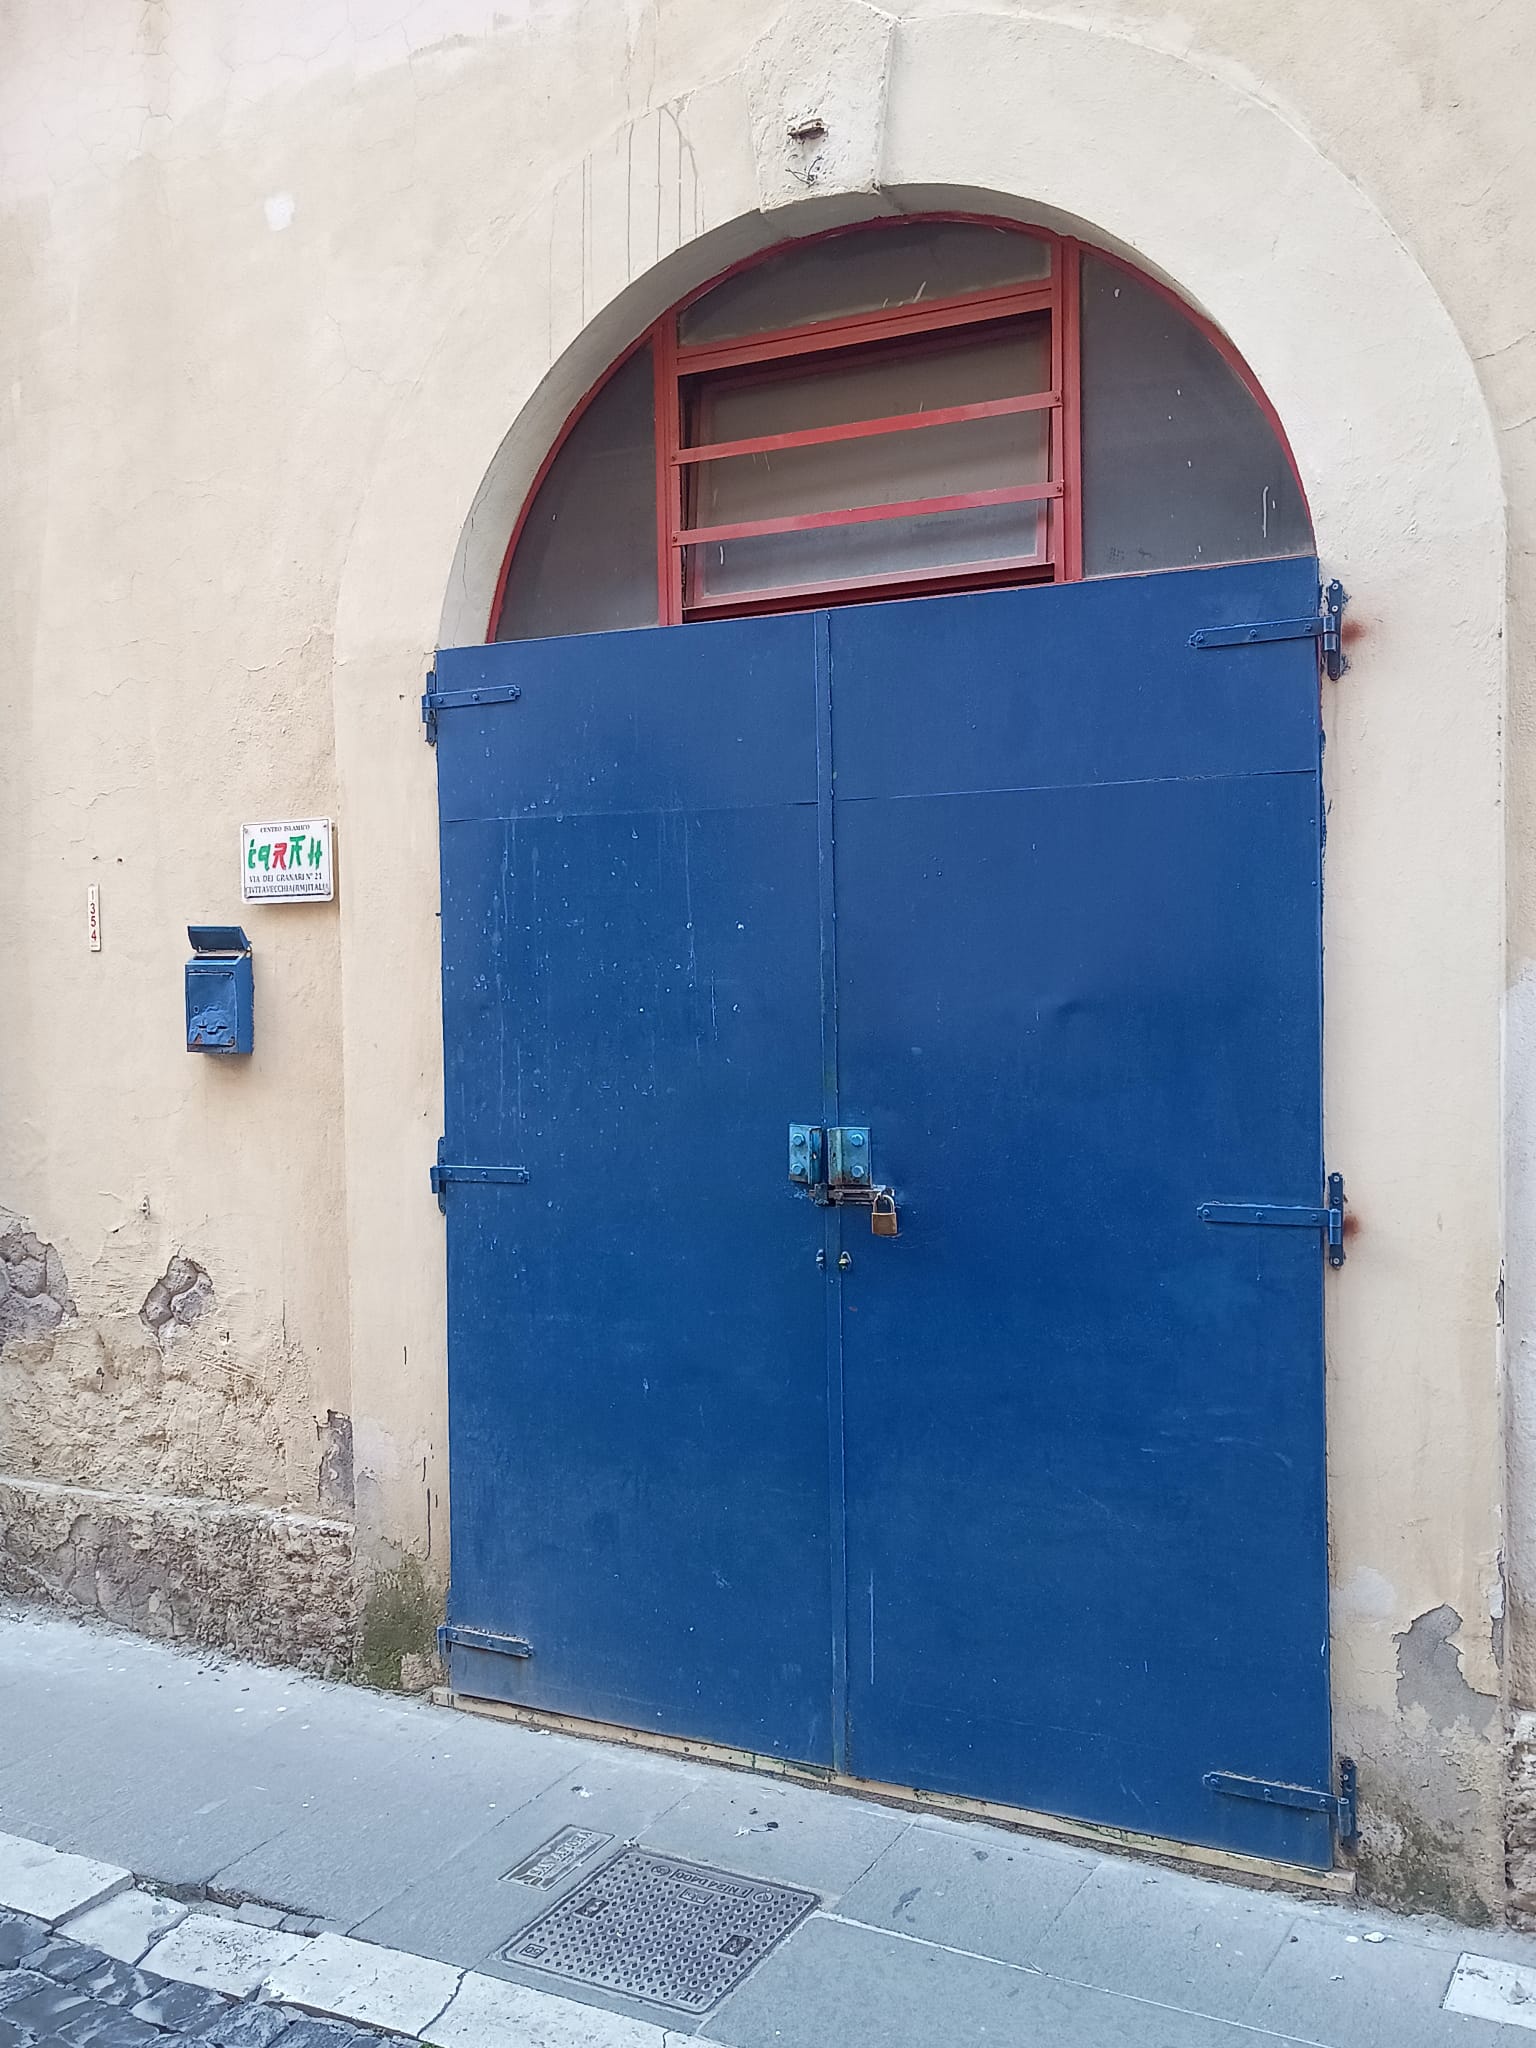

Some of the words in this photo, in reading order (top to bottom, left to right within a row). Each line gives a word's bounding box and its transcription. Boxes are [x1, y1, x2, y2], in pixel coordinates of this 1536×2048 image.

[249, 875, 261, 883] VIA
[263, 874, 274, 882] DEI
[314, 872, 323, 880] 21
